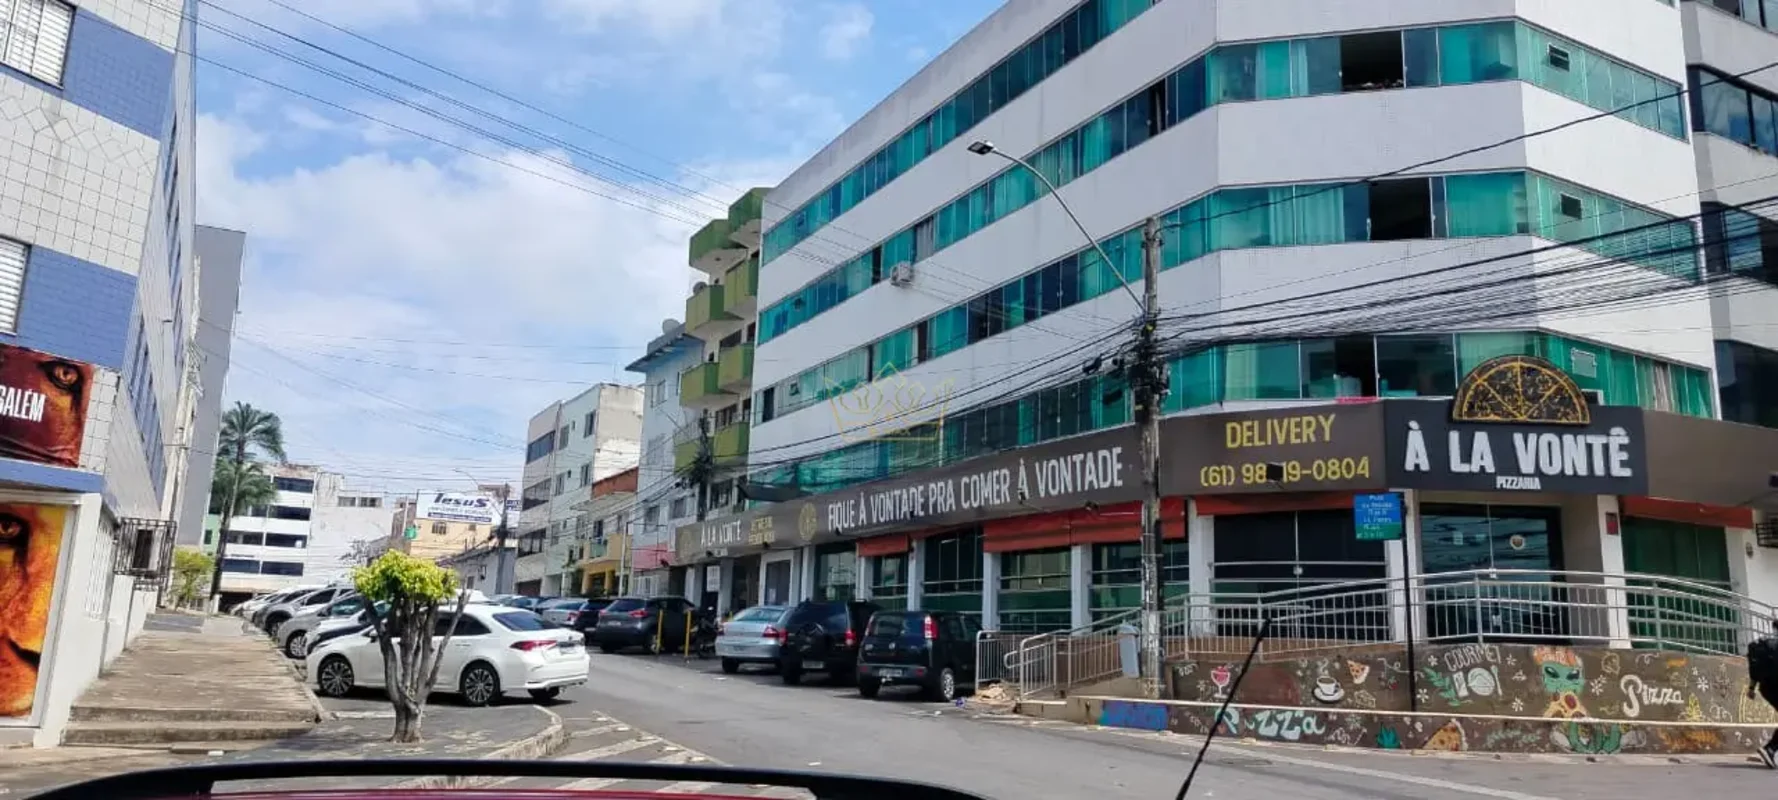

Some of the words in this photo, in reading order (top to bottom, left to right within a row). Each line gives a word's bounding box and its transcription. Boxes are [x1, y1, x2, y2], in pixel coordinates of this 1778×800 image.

[1226, 413, 1336, 448] DELIVERY
[1404, 420, 1430, 472] À
[1448, 430, 1496, 474] LA
[1513, 426, 1633, 478] VONTÊ
[828, 499, 855, 533] FIQUE
[858, 491, 867, 526] À
[870, 483, 925, 524] VONTADE
[928, 479, 956, 516] PRA
[961, 467, 1011, 510] COMER
[1018, 457, 1029, 501] À
[1035, 447, 1123, 499] VONTADE
[1200, 464, 1235, 487] (61)
[1242, 456, 1370, 484] 9819-0804
[1496, 475, 1541, 489] PIZZARIA
[1620, 674, 1684, 717] Pizza
